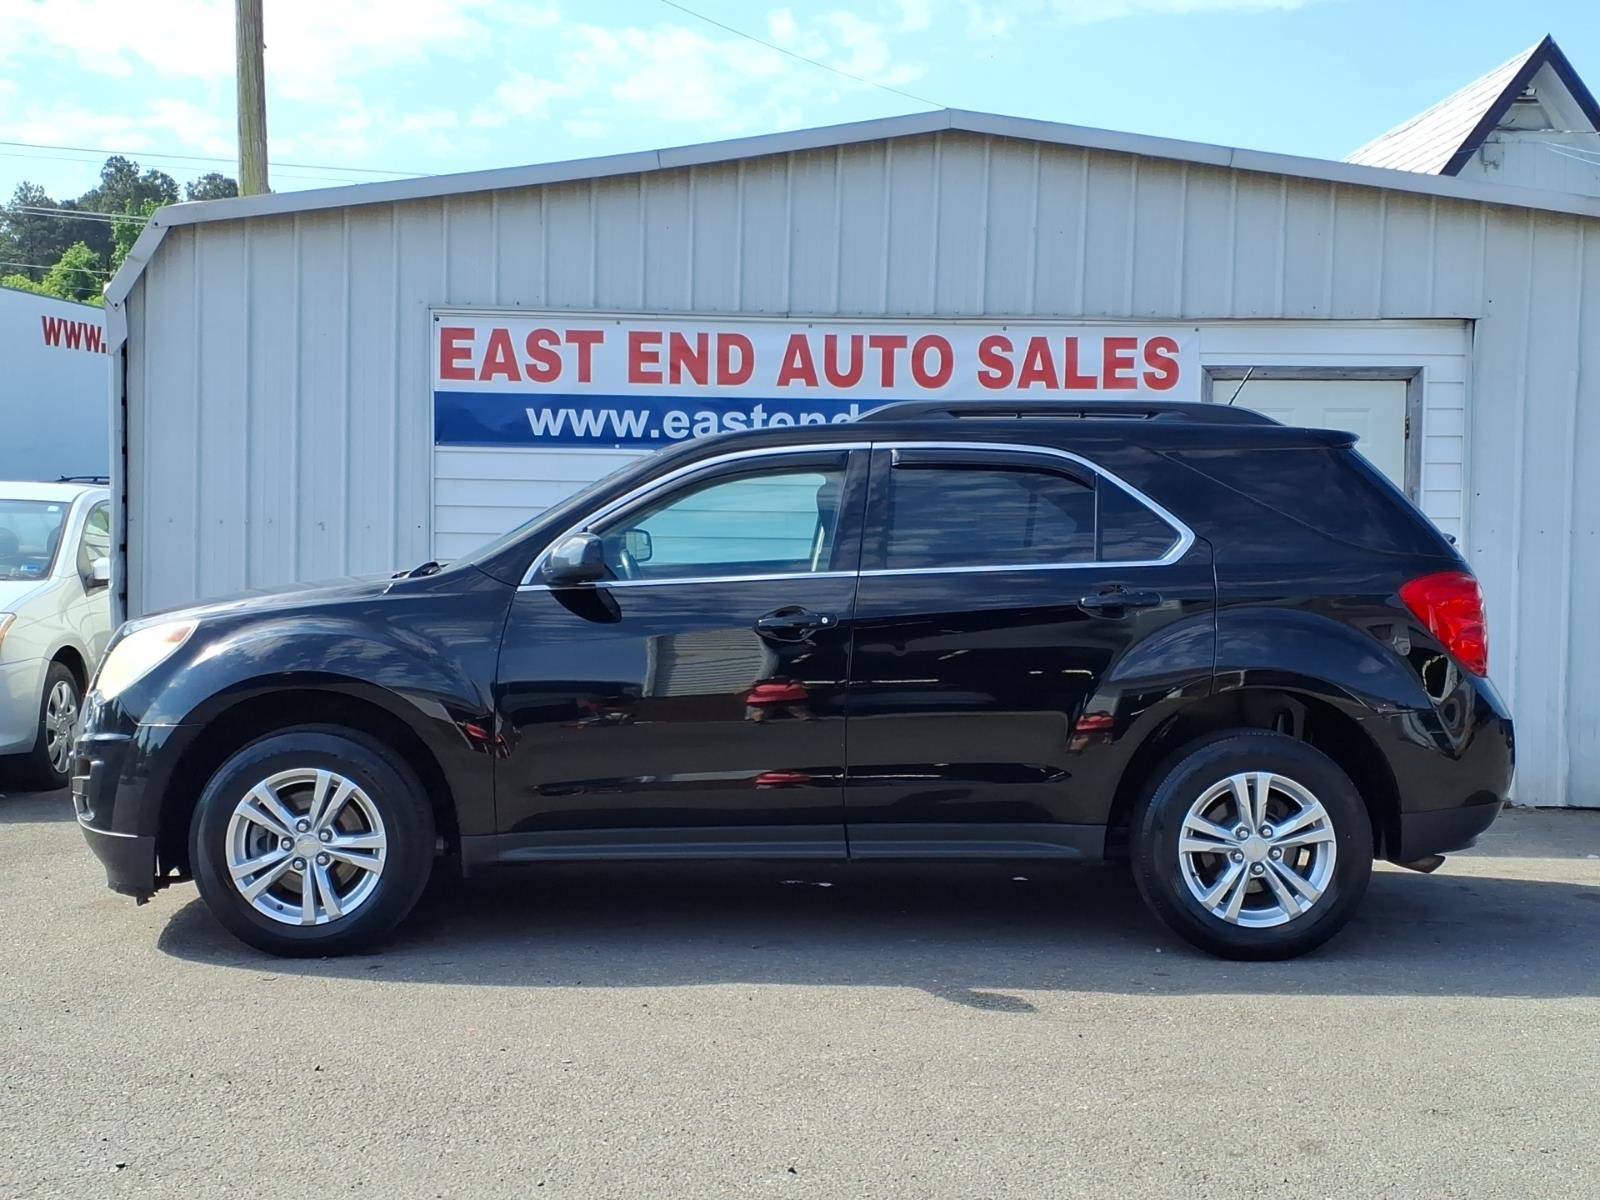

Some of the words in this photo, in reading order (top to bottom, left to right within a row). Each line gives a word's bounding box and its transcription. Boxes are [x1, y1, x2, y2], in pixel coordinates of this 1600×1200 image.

[41, 315, 107, 354] WWW.
[439, 327, 605, 384] EAST
[627, 330, 756, 387] END
[776, 333, 955, 390] AUTO
[977, 335, 1181, 391] SALES
